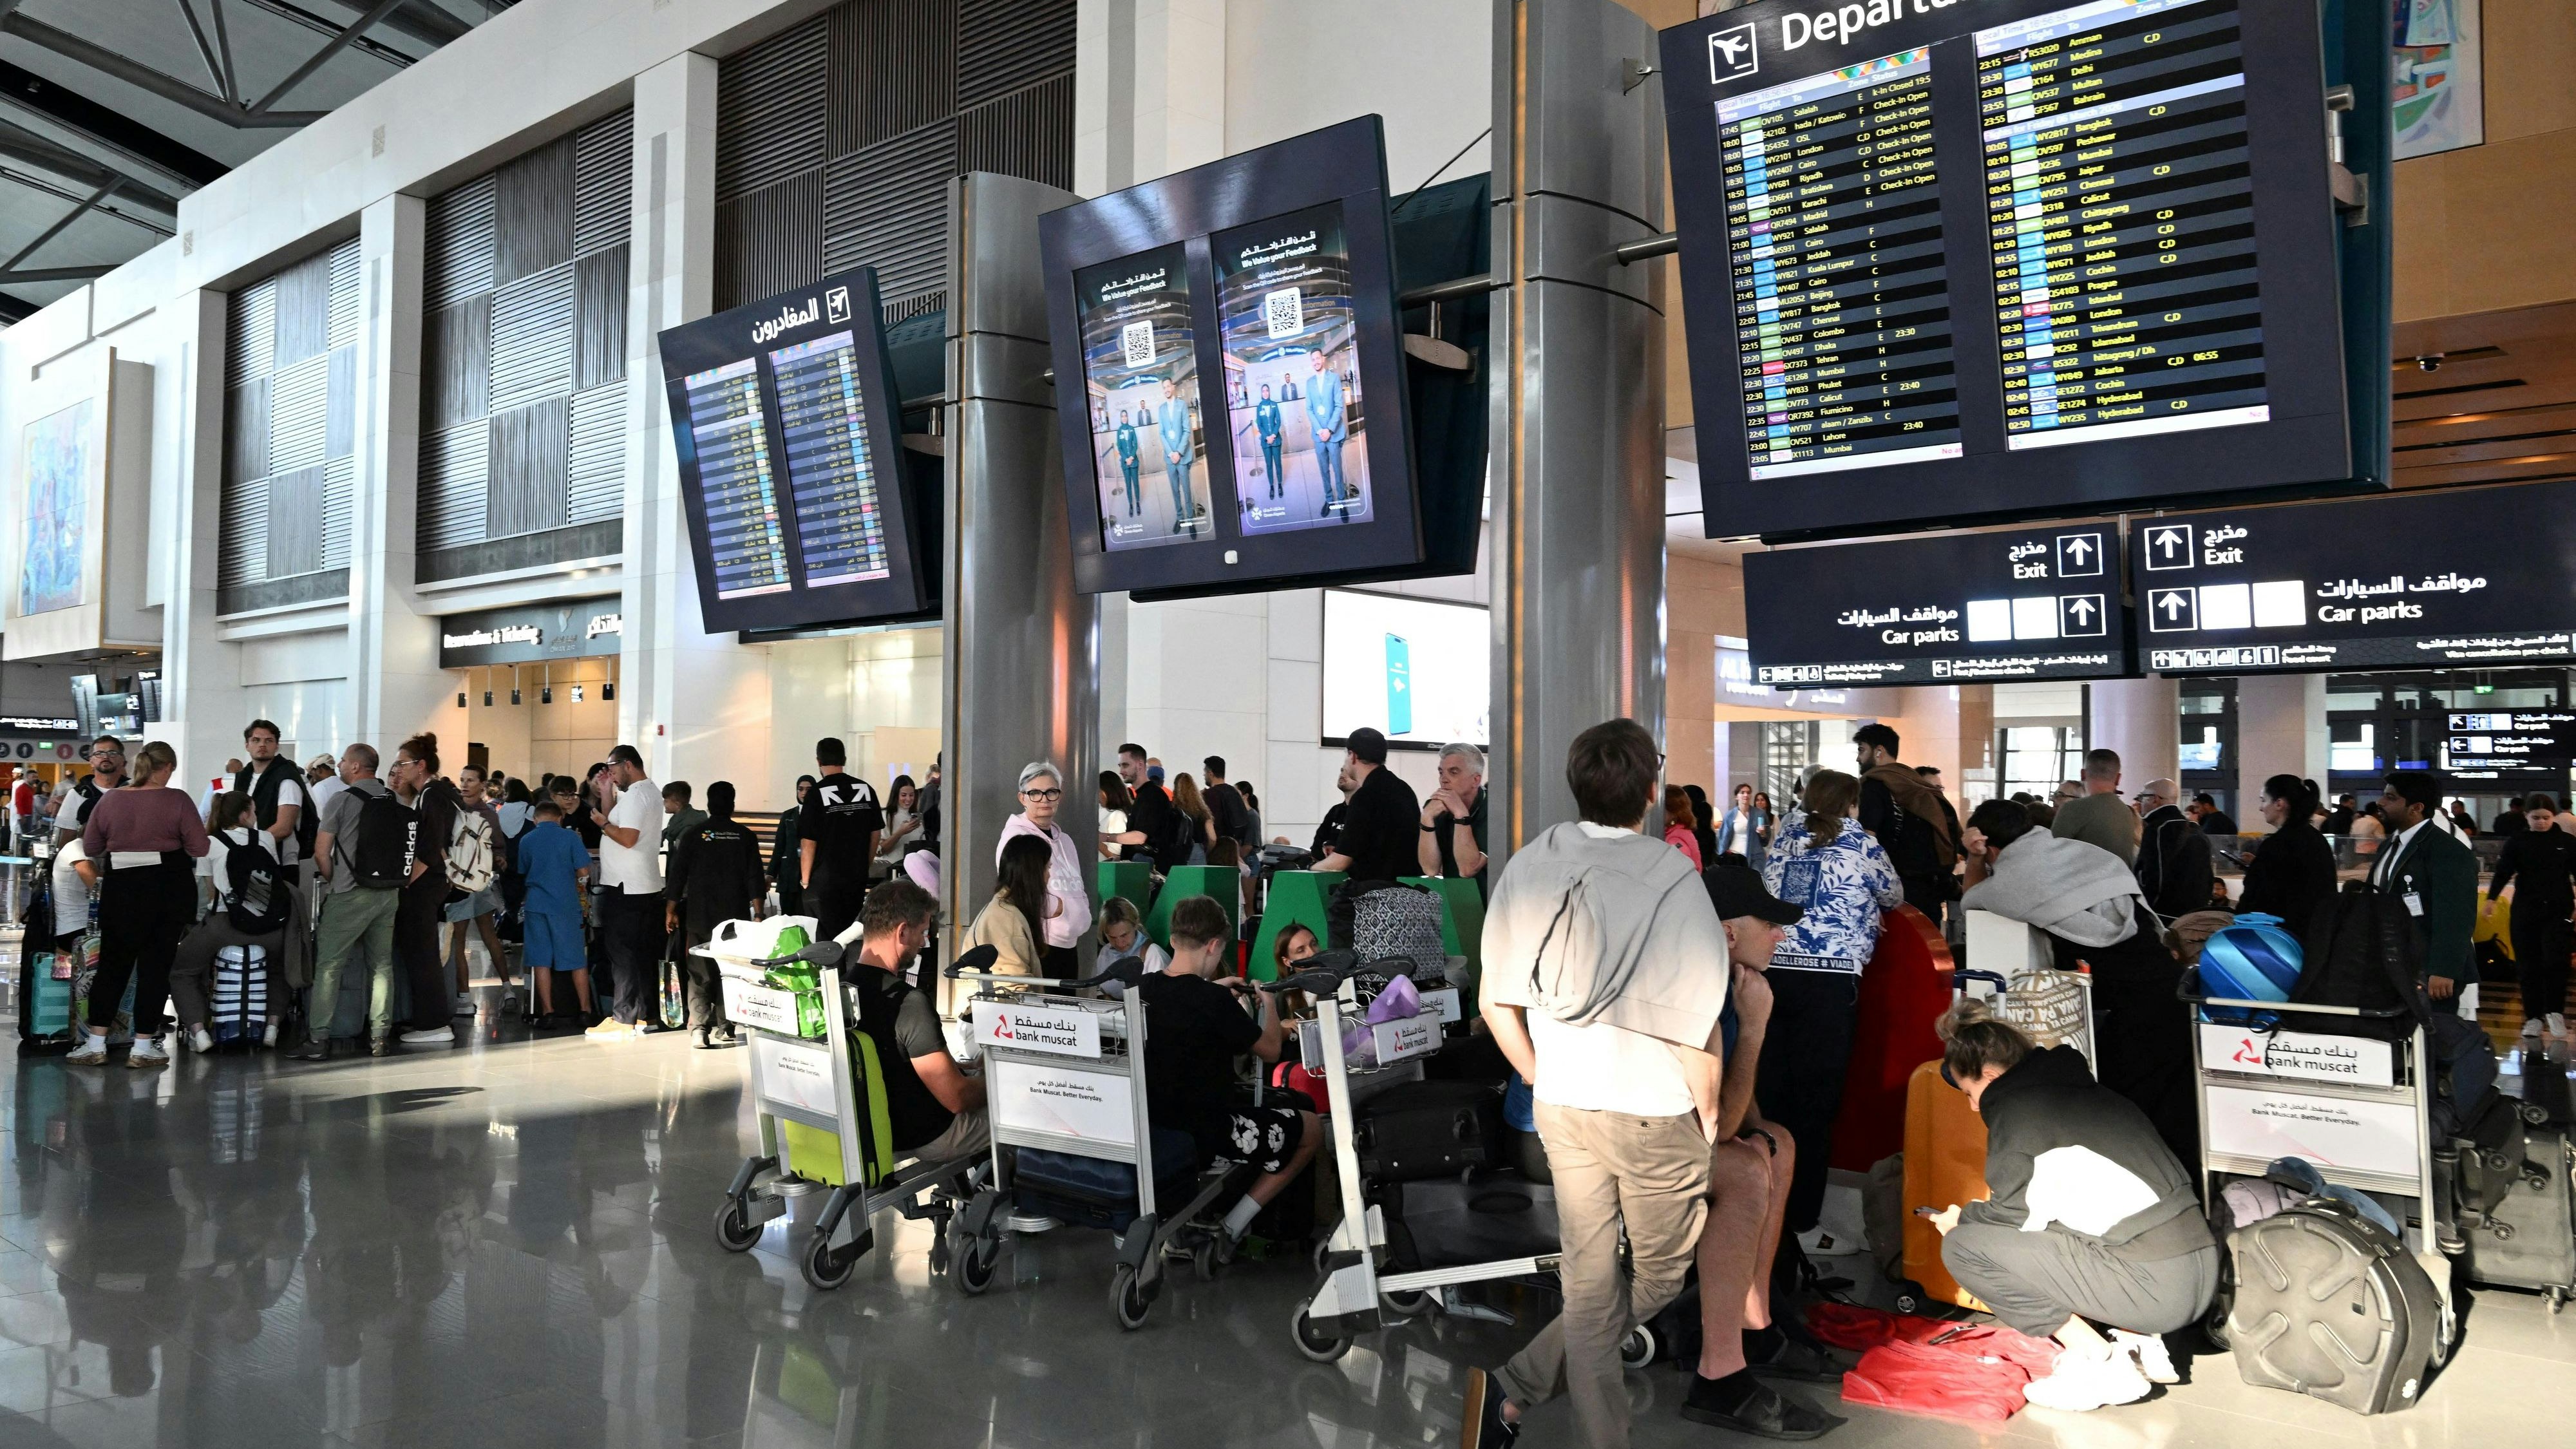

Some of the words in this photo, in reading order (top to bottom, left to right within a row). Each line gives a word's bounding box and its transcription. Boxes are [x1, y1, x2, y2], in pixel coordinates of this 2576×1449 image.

[1739, 95, 1757, 105] Time
[1761, 86, 1793, 101] 16:56:55
[1759, 100, 1781, 111] Flight
[1793, 95, 1803, 103] To
[1848, 78, 1869, 88] Zone
[1871, 70, 1898, 81] Status
[1721, 125, 1739, 136] 17:45
[1761, 114, 1784, 126] OV105
[1794, 104, 1819, 117] Salalah
[1857, 93, 1863, 101] E
[1888, 79, 1914, 92] Closed
[2099, 101, 2123, 115] 2026
[1725, 164, 1743, 174] 18:05
[1765, 152, 1792, 164] WY2101
[1797, 146, 1824, 156] London
[1876, 124, 1909, 137] Check-In
[1909, 119, 1931, 129] Open
[1727, 189, 1745, 199] 18:50
[1767, 179, 1790, 190] WY681
[1799, 171, 1823, 183] Riyadh
[1878, 151, 1911, 164] Check-In
[1911, 147, 1933, 157] Open
[1730, 214, 1747, 225] 19:05
[1769, 205, 1791, 216] OV511
[1801, 196, 1827, 209] Karachi
[1866, 187, 1871, 195] E
[1880, 178, 1913, 191] Check-In
[1914, 174, 1935, 184] Open
[1730, 227, 1748, 238] 20:35
[1770, 217, 1797, 229] QR7494
[1803, 209, 1828, 222] Madrid
[1866, 200, 1873, 209] H
[1242, 260, 1253, 268] We
[1253, 256, 1270, 265] Value
[1270, 252, 1285, 262] your
[1285, 243, 1317, 257] Feedback
[1733, 253, 1751, 263] 21:10
[1773, 244, 1795, 255] MS931
[1805, 239, 1824, 247] Cairo
[1736, 278, 1753, 289] 21:35
[1776, 270, 1797, 280] WY821
[1808, 264, 1827, 274] Kuala
[1827, 260, 1855, 270] Lumpur
[1111, 291, 1126, 299] Value
[1126, 287, 1139, 297] your
[1139, 280, 1166, 292] Feedback
[752, 298, 819, 344] المغادرون
[1739, 316, 1756, 326] 22:05
[1779, 308, 1802, 319] WY817
[1811, 301, 1841, 312] Bangkok
[1742, 354, 1760, 364] 22:20
[1783, 347, 1804, 357] OV497
[1814, 342, 1837, 352] Dhaka
[1895, 327, 1916, 337] 23:30
[2204, 524, 2248, 547] مخرج
[2009, 541, 2047, 562] مخرج
[2204, 547, 2244, 565] Exit
[2012, 562, 2048, 579] Exit
[2316, 576, 2404, 600] السيارات
[2408, 572, 2487, 594] مواقف
[1837, 607, 1900, 627] السيارات
[1902, 605, 1958, 623] مواقف
[2318, 605, 2356, 623] Car
[2361, 601, 2423, 625] parks
[1882, 629, 1910, 645] Car
[1913, 627, 1960, 647] parks
[403, 821, 417, 876] adidas
[1821, 958, 1828, 967] #
[1015, 1016, 1052, 1029] مسقط
[1054, 1019, 1076, 1035] بنك
[1016, 1028, 1039, 1043] bank
[1042, 1035, 1077, 1046] muscat
[1403, 1037, 1414, 1050] bank
[1414, 1036, 1428, 1046] muscat
[2324, 1046, 2358, 1061] بنك
[2305, 1061, 2358, 1074] muscat
[1079, 1093, 1103, 1103] Everyday.
[2252, 1108, 2269, 1116] Bank
[2271, 1110, 2298, 1119] Muscat.
[2325, 1116, 2362, 1126] Everyday.
